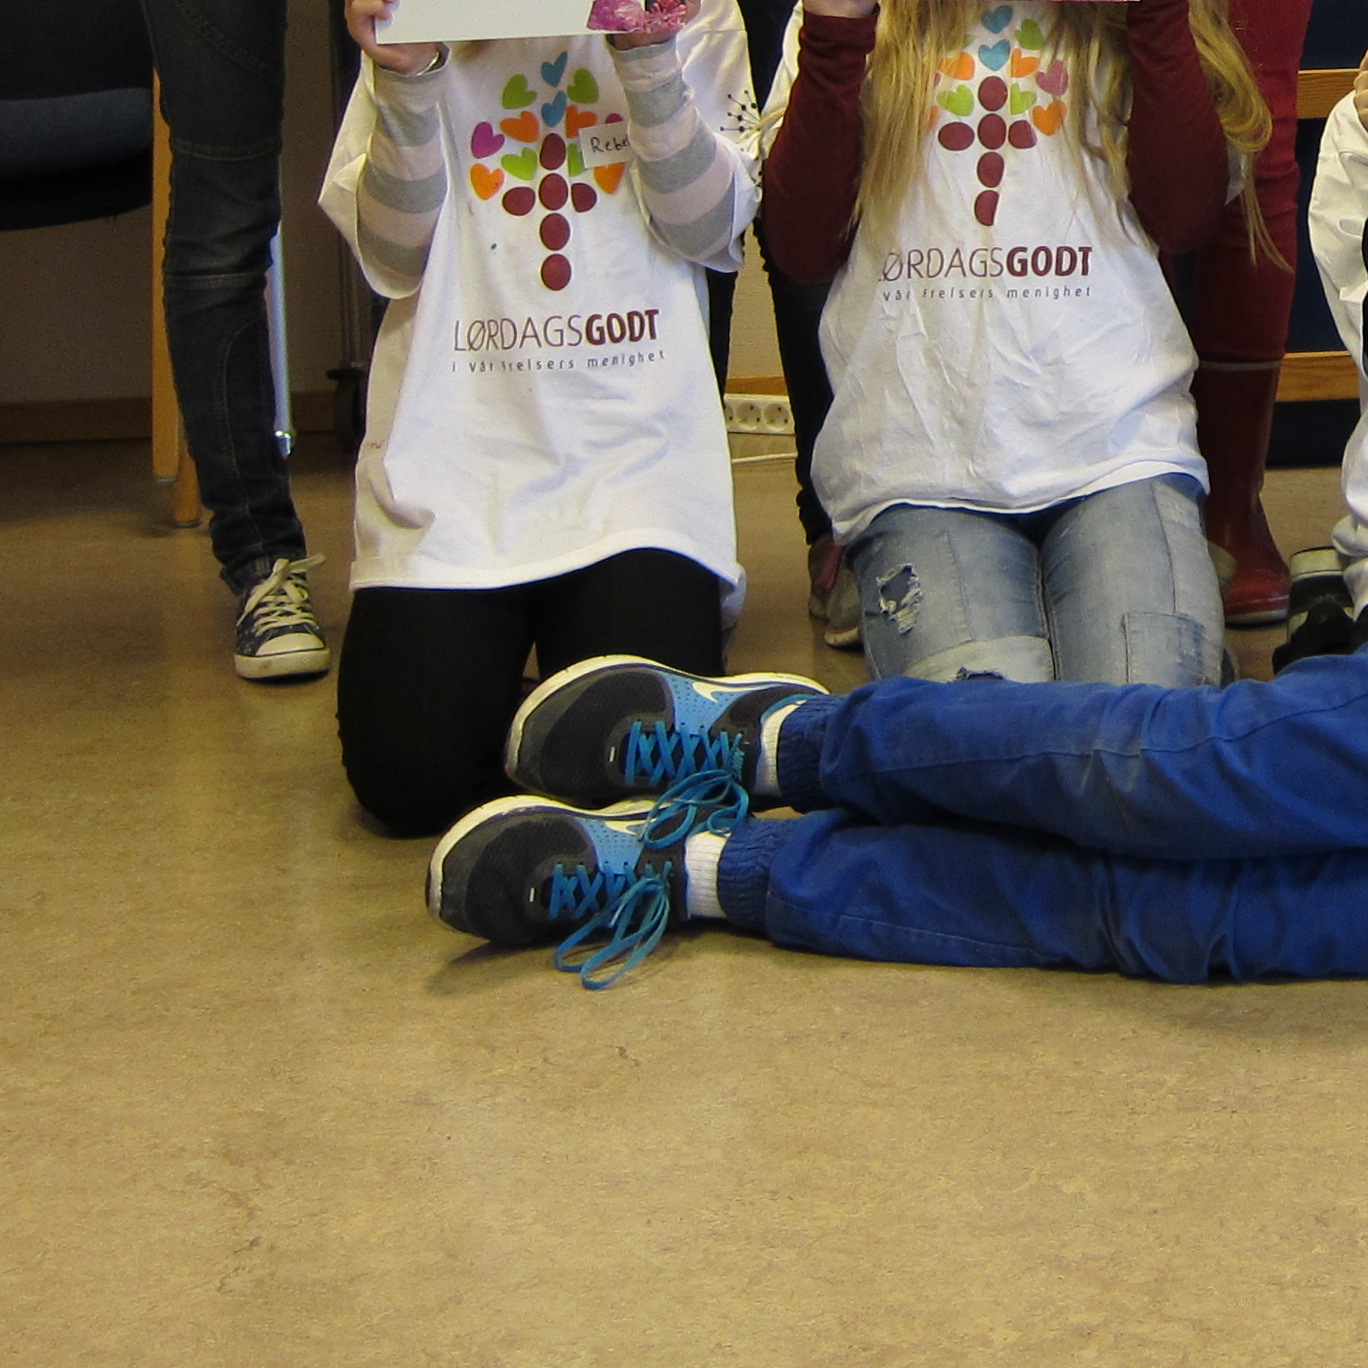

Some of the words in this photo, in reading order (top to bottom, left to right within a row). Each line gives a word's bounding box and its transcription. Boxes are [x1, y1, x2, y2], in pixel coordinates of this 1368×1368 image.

[881, 245, 1093, 282] ØRDAGSGODT
[1006, 285, 1092, 300] menighet
[453, 308, 660, 352] LØRDAGSGODT
[586, 349, 665, 369] menighet
